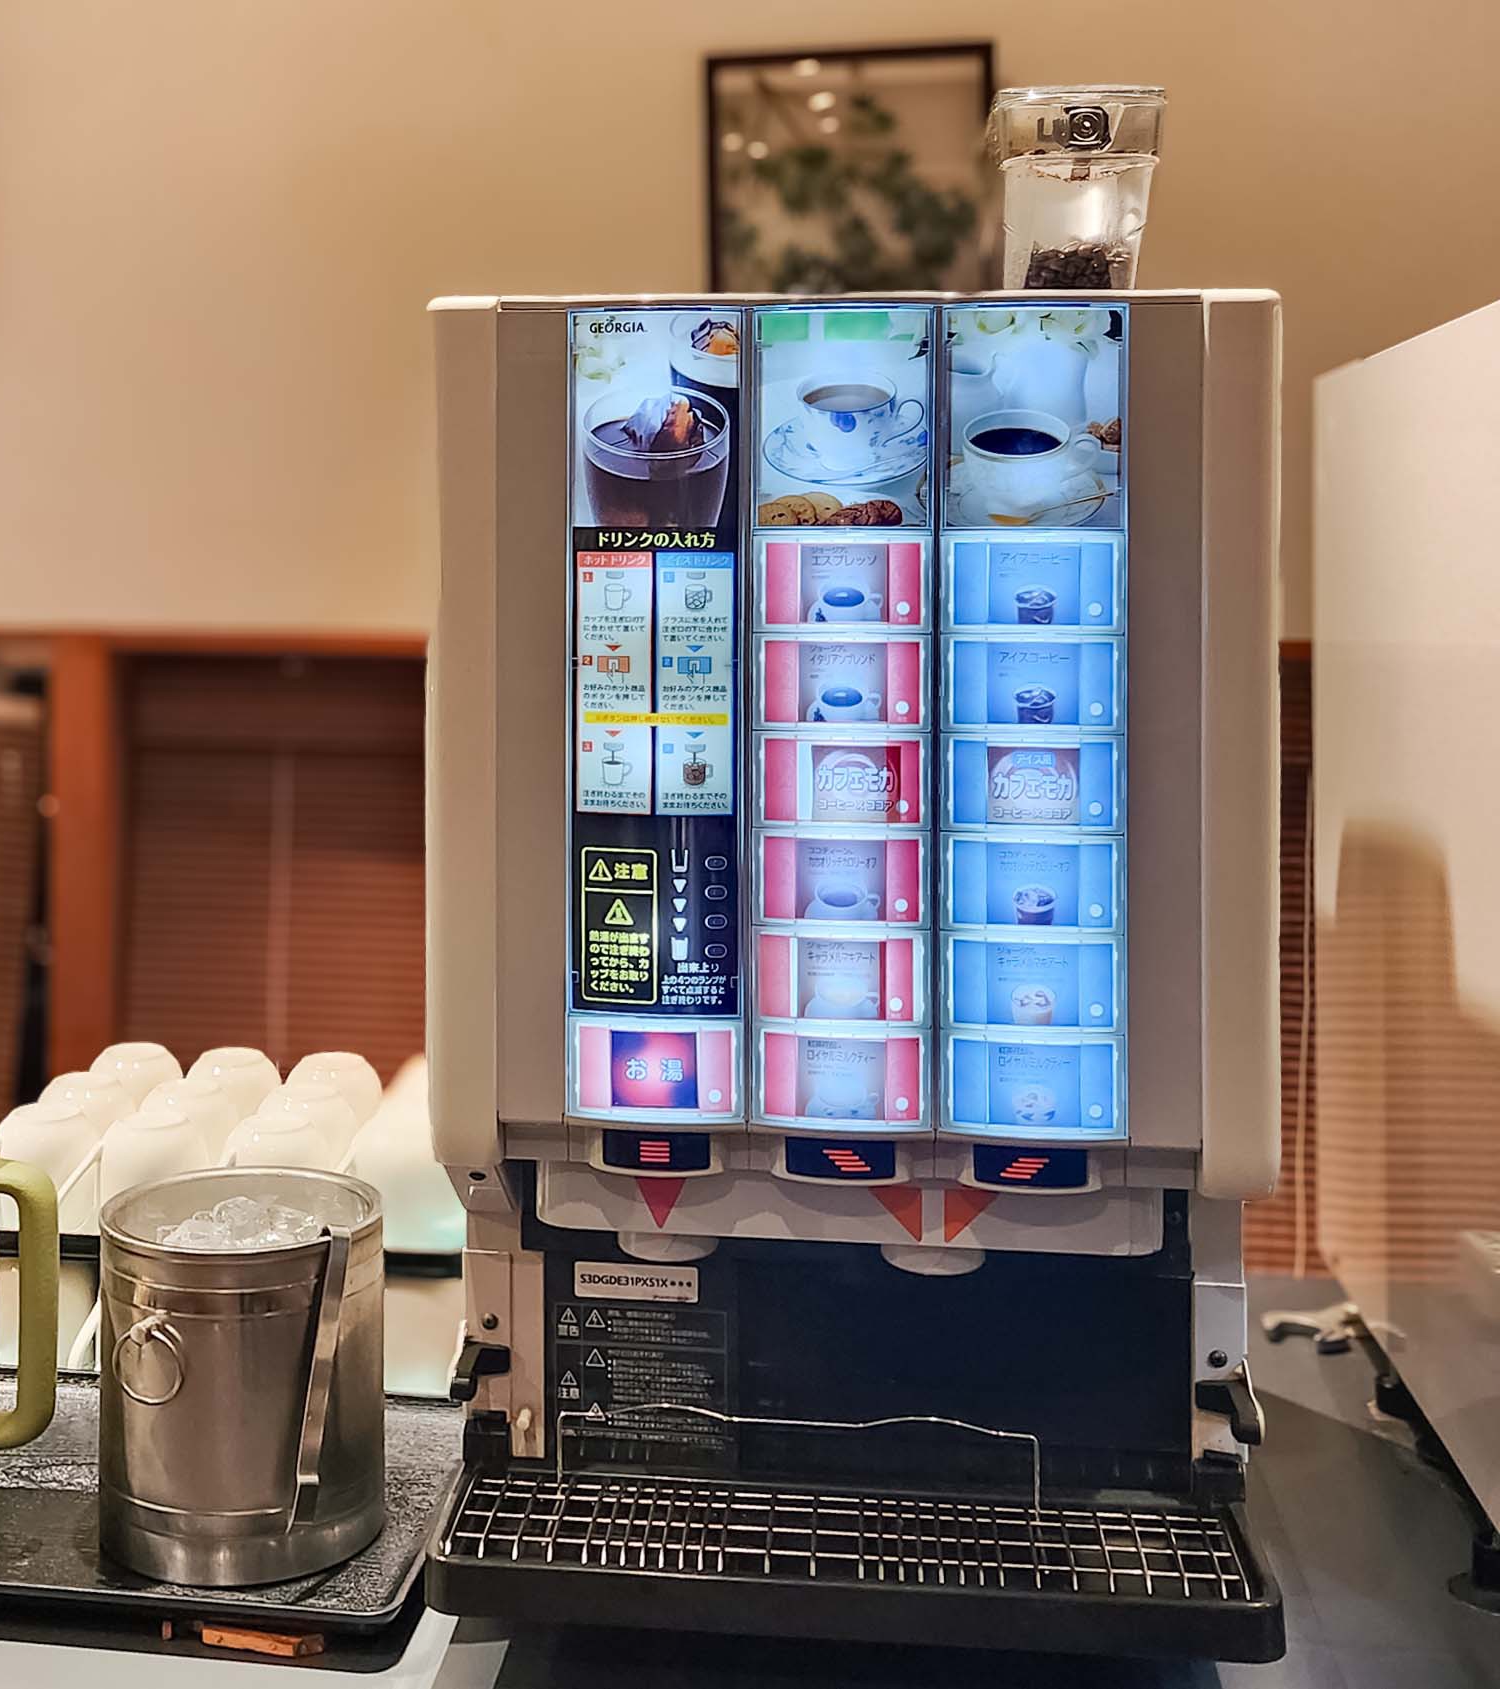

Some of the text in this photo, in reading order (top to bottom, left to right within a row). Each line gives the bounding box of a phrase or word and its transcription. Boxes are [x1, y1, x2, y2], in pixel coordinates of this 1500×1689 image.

[589, 318, 645, 334] GEORGIA
[598, 532, 716, 548] ドリンクの入れ方
[818, 765, 894, 793] カフェモカ
[993, 773, 1073, 800] カフェモカ
[614, 863, 649, 880] 注意
[590, 982, 635, 994] ください。
[625, 1058, 684, 1082] お湯
